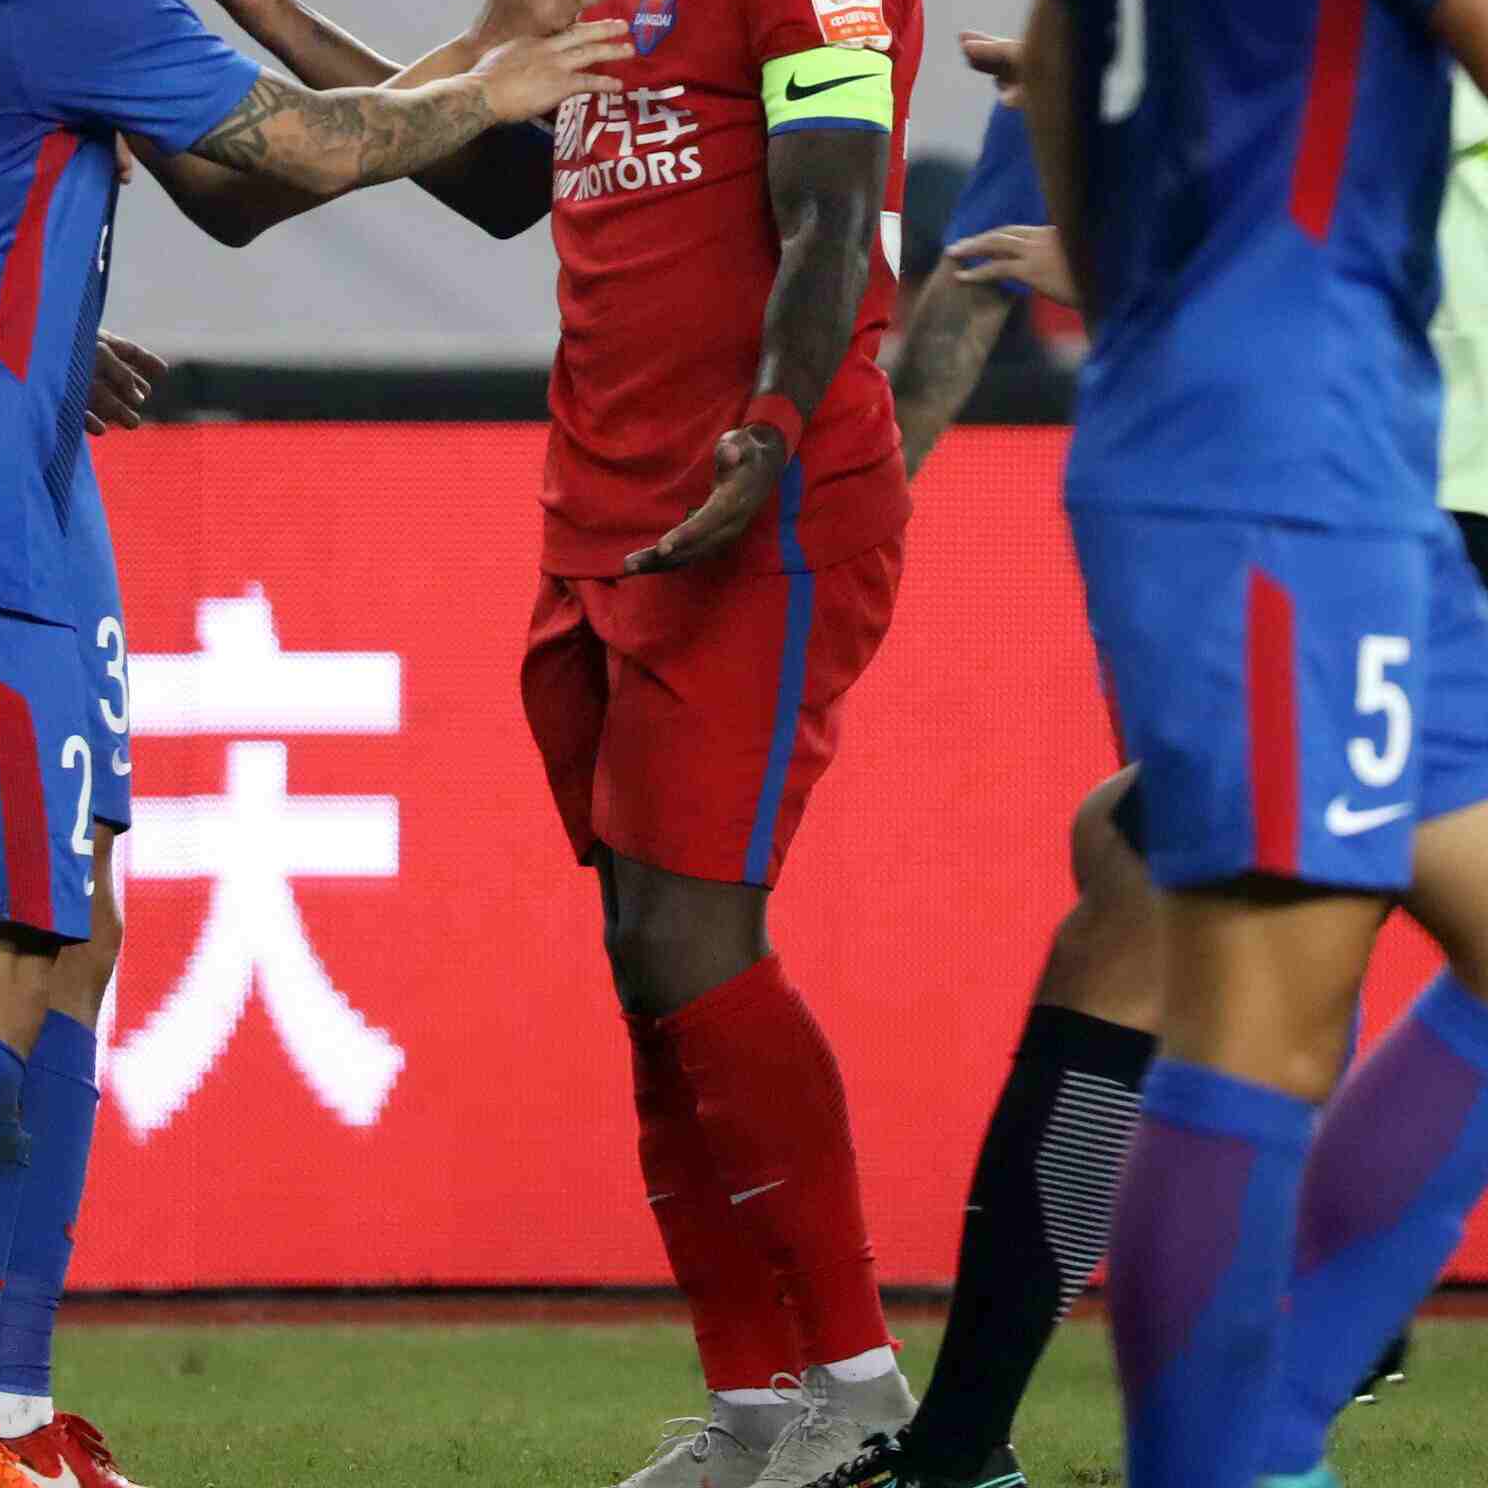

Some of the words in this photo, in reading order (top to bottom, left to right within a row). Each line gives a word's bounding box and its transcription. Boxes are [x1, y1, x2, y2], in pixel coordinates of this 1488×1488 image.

[96, 616, 129, 734] 3
[1346, 634, 1412, 787] 5
[62, 734, 94, 856] 2
